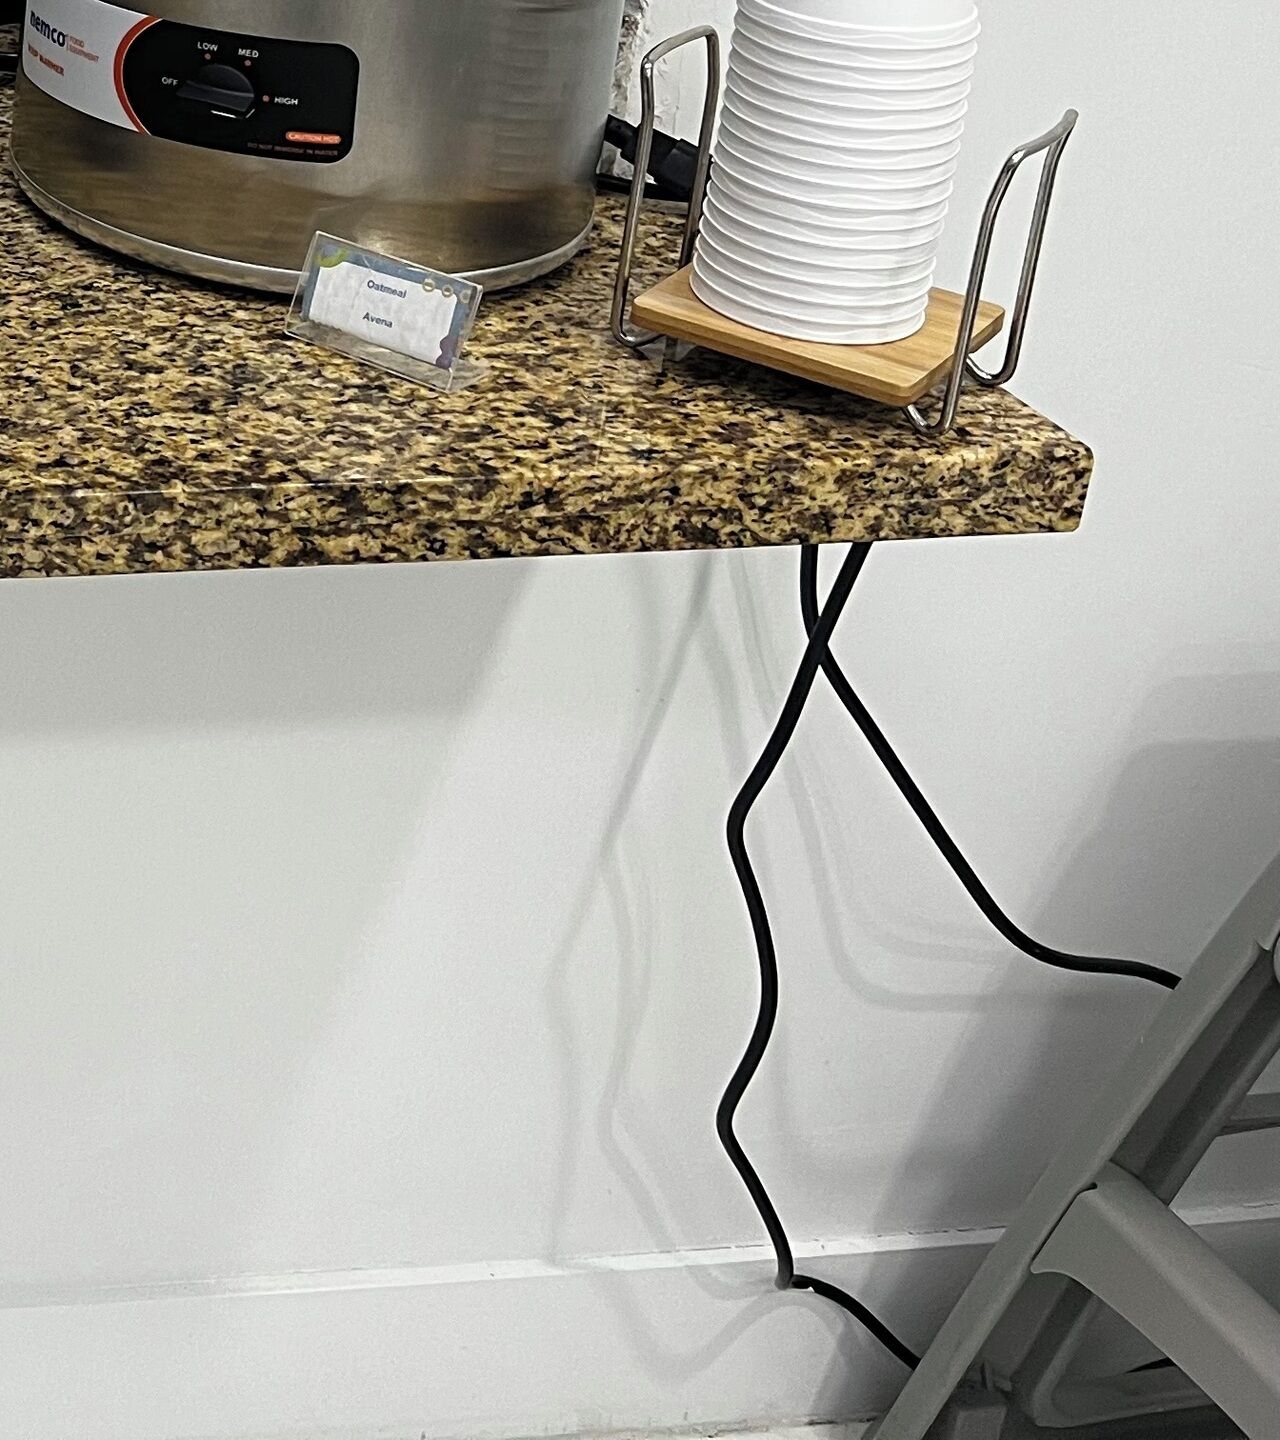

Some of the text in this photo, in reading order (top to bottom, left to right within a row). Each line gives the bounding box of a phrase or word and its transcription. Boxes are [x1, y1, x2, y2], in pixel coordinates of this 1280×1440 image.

[30, 9, 66, 48] nemco
[197, 41, 218, 52] LOW
[238, 48, 259, 58] MED
[161, 76, 179, 86] OFF
[274, 96, 299, 106] HIGH
[366, 279, 408, 299] Oatmeal
[362, 311, 393, 328] Avena
